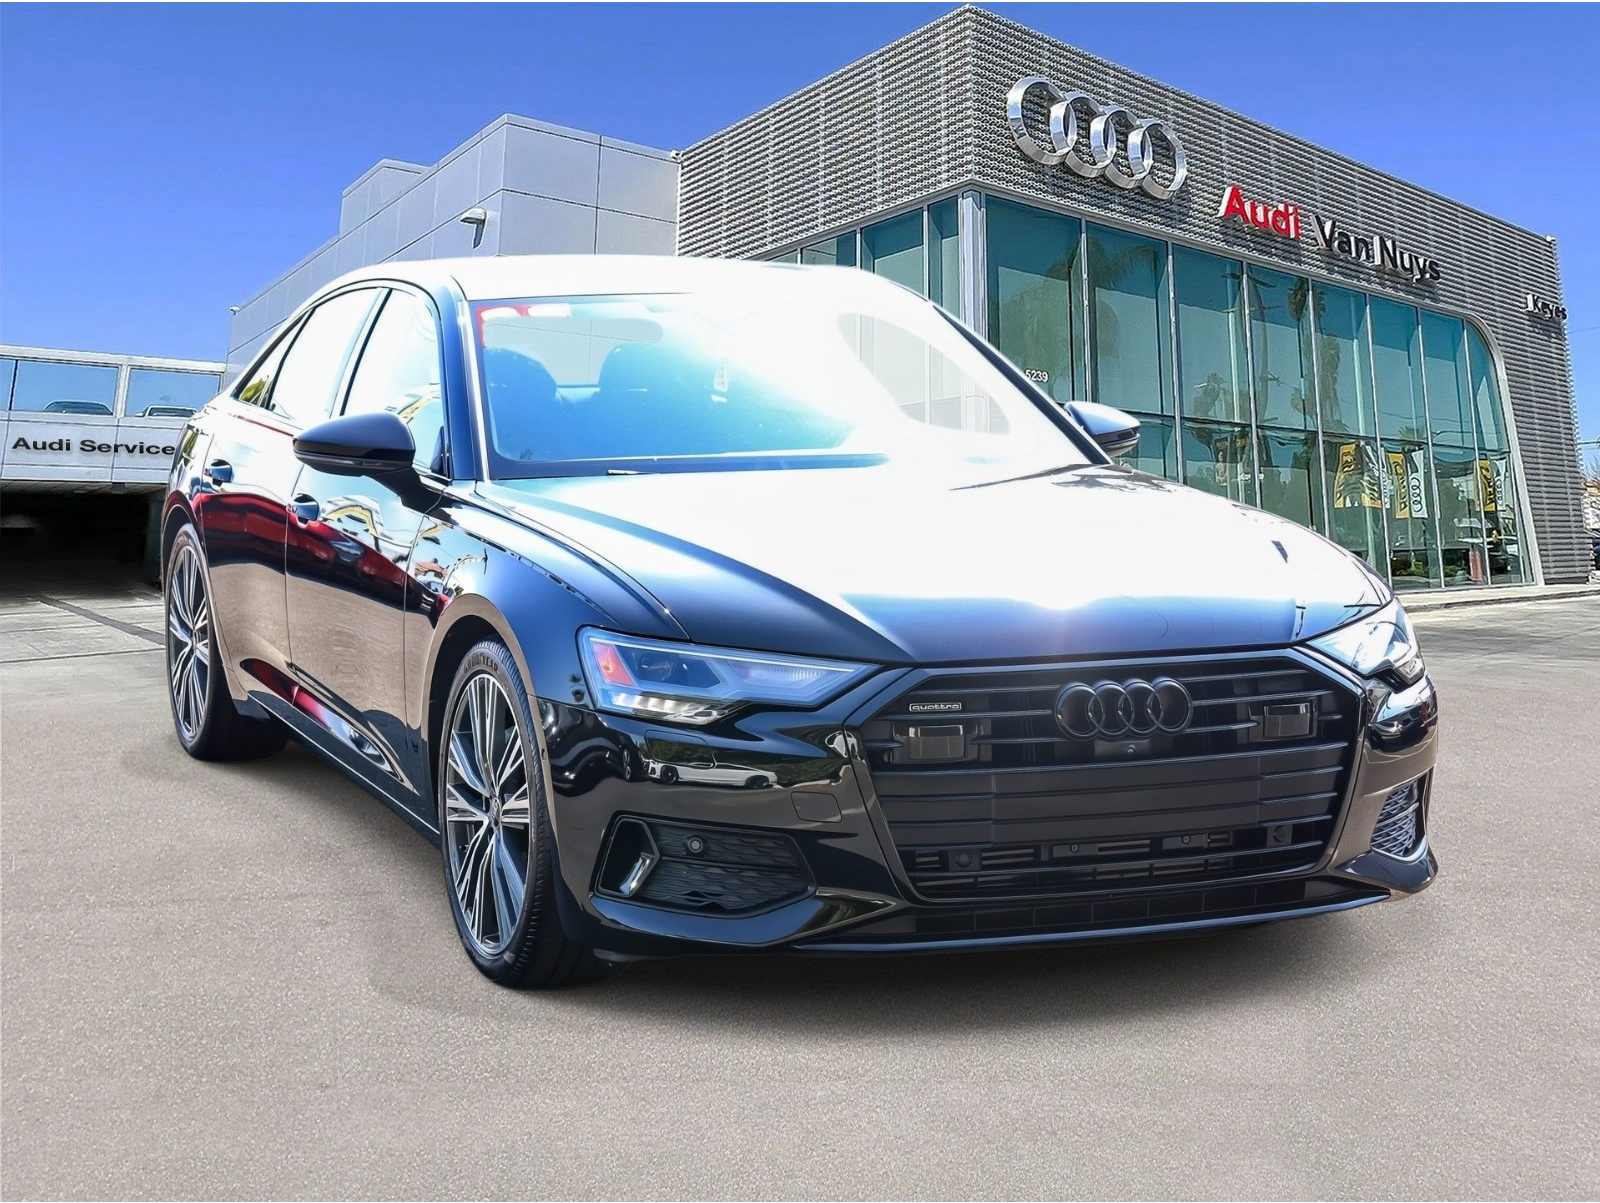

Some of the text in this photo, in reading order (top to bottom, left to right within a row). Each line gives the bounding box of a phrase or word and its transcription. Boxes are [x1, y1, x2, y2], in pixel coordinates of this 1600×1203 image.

[1216, 184, 1440, 283] Audi Van Nuys
[12, 437, 175, 456] Audi Service
[911, 703, 960, 711] quattro
